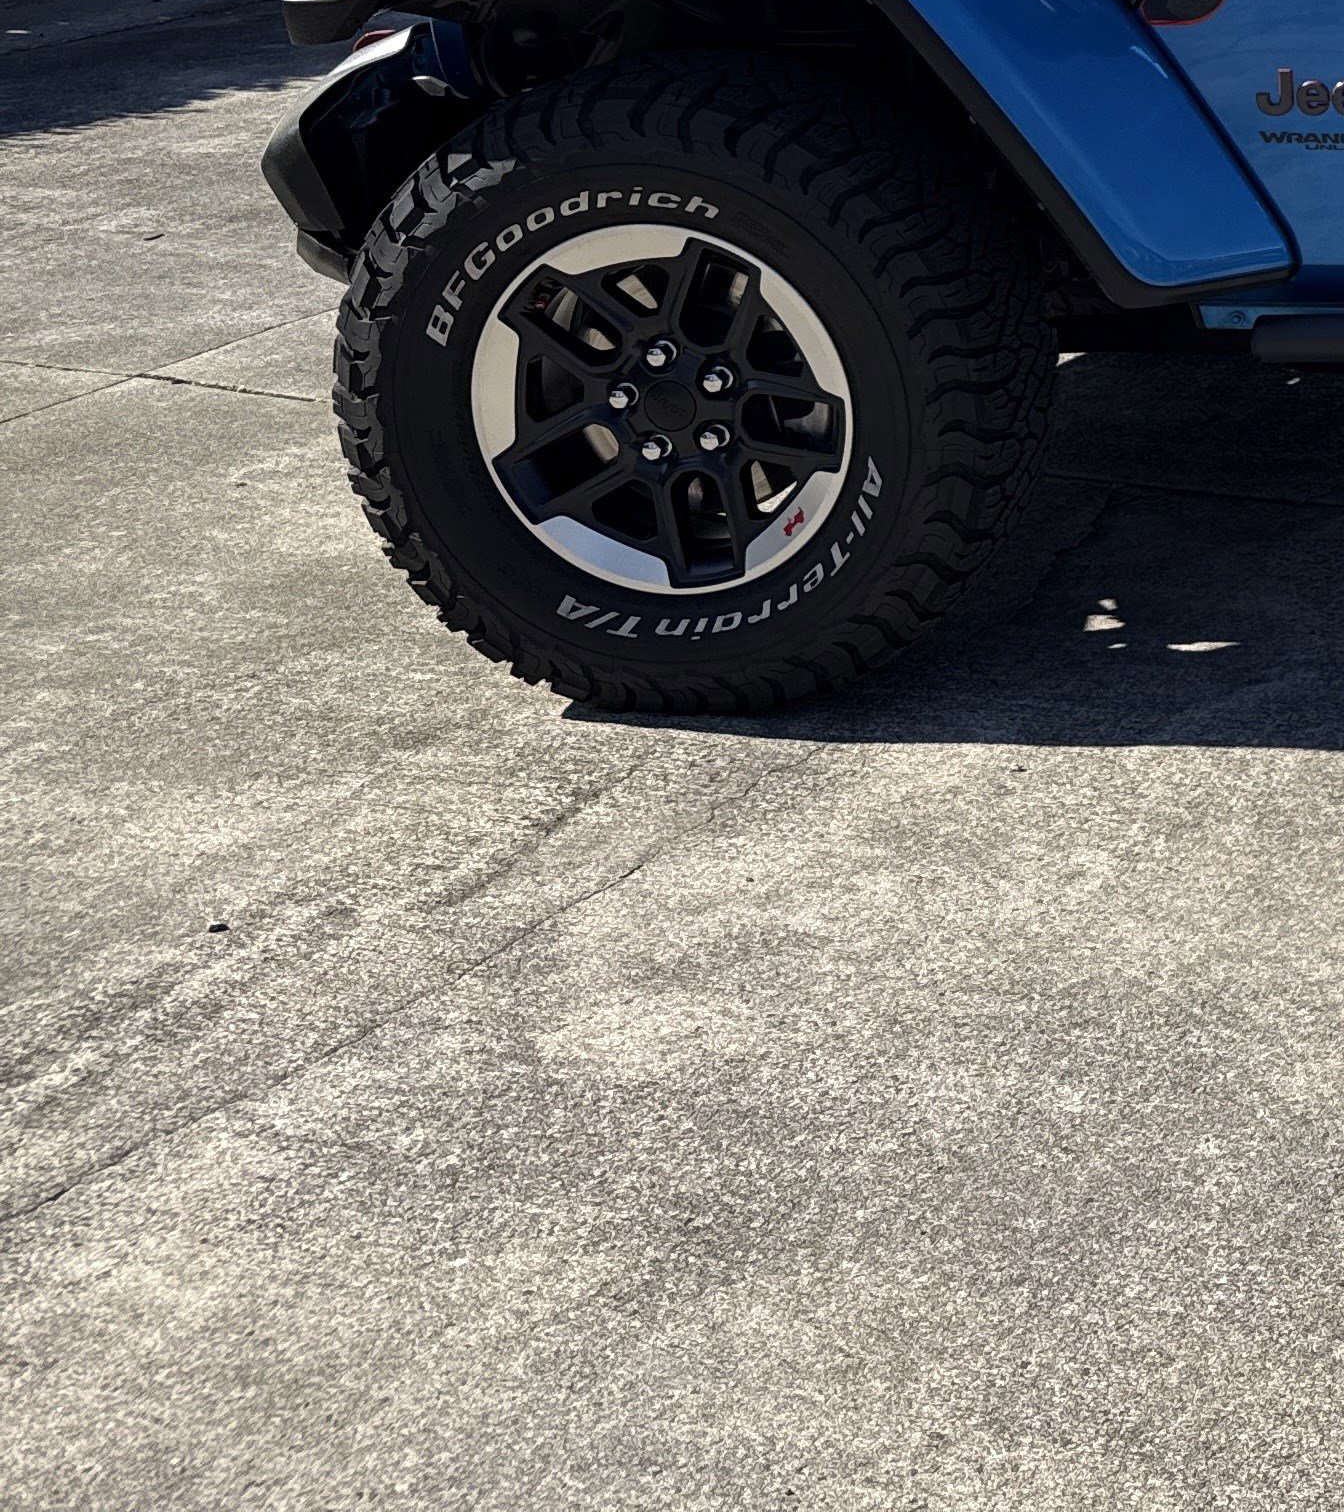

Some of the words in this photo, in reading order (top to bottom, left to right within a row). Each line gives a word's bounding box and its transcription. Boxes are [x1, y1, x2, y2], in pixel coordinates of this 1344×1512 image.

[425, 185, 720, 347] BFGoodrich
[556, 593, 643, 640] T/A
[654, 454, 885, 642] All-Terrain
